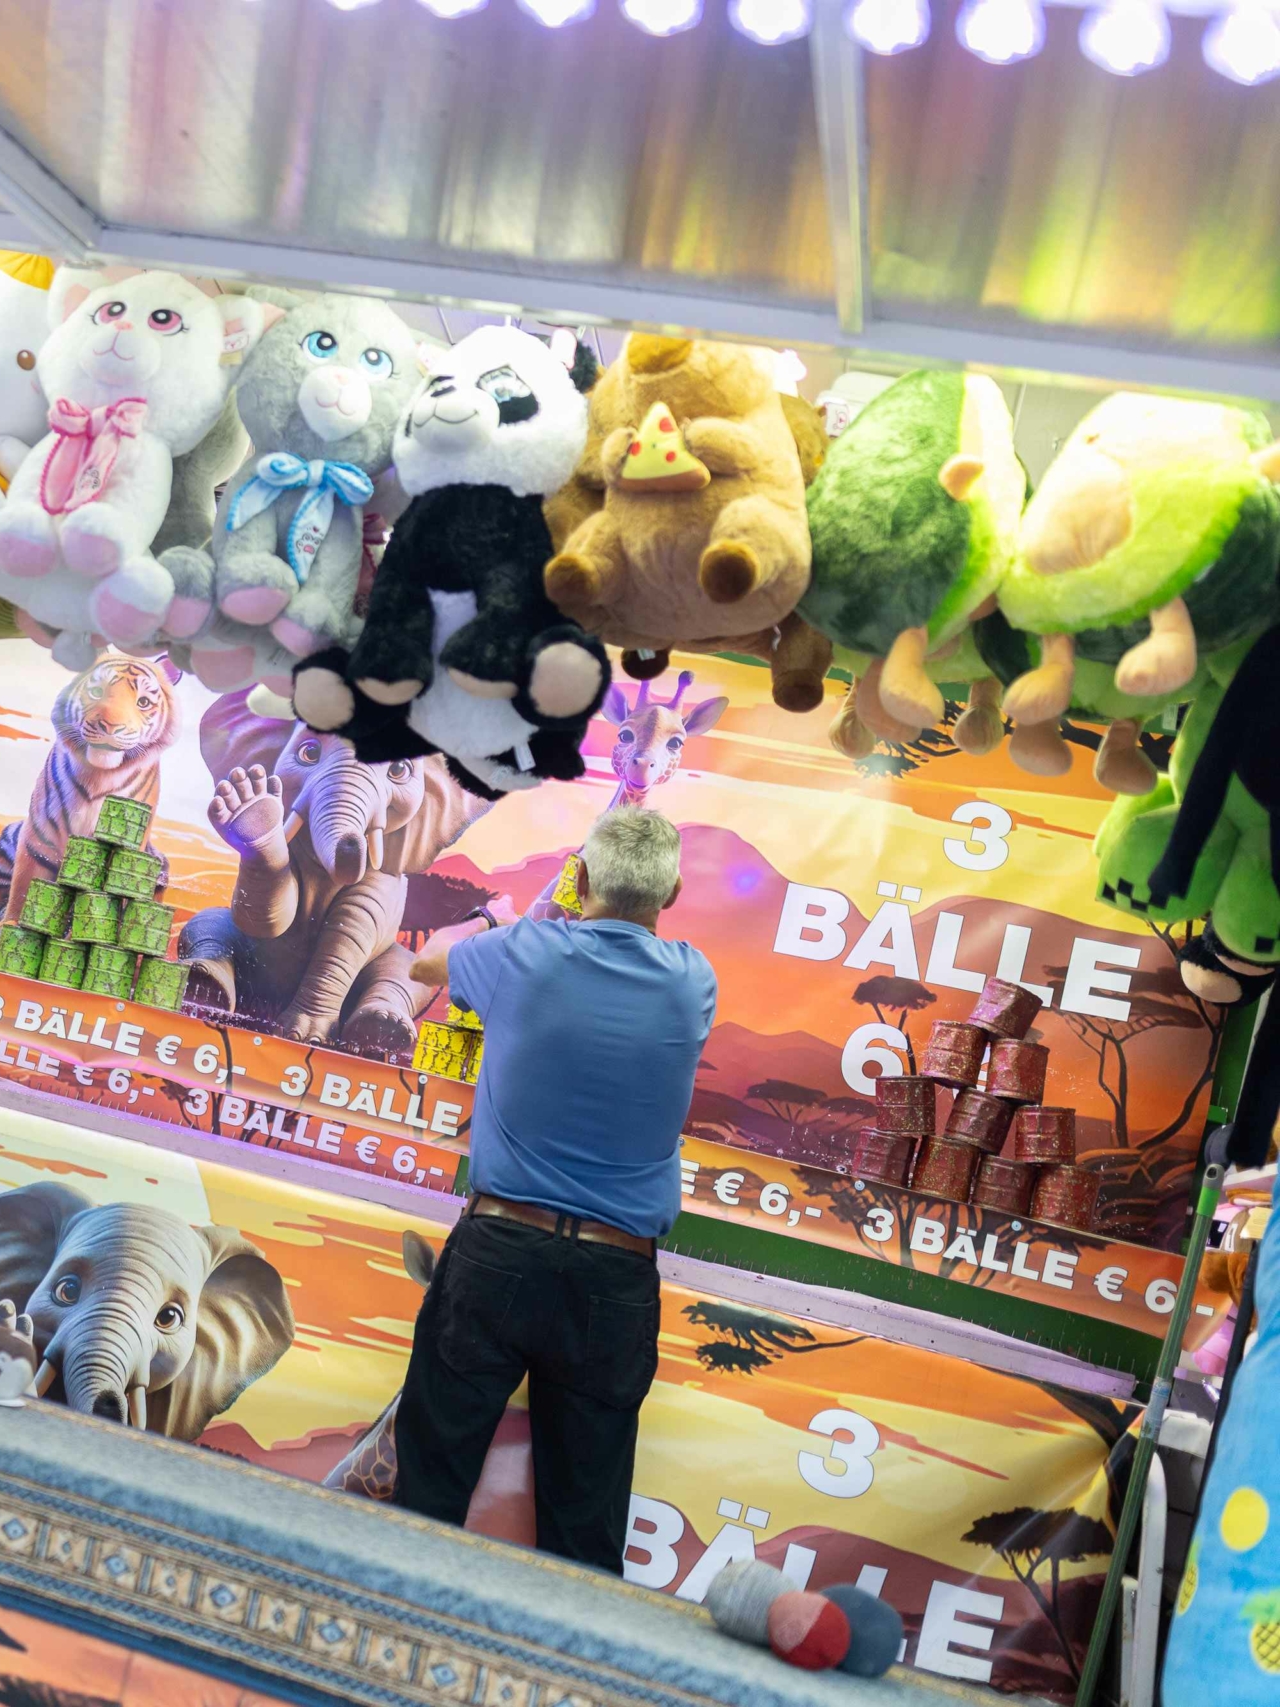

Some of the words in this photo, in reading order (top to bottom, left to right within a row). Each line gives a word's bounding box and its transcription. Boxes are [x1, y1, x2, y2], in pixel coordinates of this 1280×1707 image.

[943, 801, 1013, 871] 3
[773, 882, 1141, 1022] BÄLLE
[15, 999, 147, 1057] BÄLLE
[154, 1034, 182, 1066] €
[192, 1043, 246, 1084] 6,-
[280, 1065, 309, 1097] 3
[320, 1073, 463, 1137] BÄLLE
[841, 1023, 909, 1096] 6
[73, 1064, 94, 1087] €
[108, 1067, 155, 1104] 6,-
[185, 1087, 209, 1118] 3
[219, 1094, 346, 1155] BÄLLE
[355, 1135, 381, 1166] €
[392, 1146, 445, 1184] 6,-
[713, 1171, 745, 1205] €
[759, 1183, 822, 1227] 6,-
[862, 1209, 895, 1242] 3
[910, 1218, 1081, 1290] BÄLLE
[1093, 1266, 1129, 1301] €
[1144, 1279, 1215, 1317] 6-
[797, 1408, 882, 1498] 3
